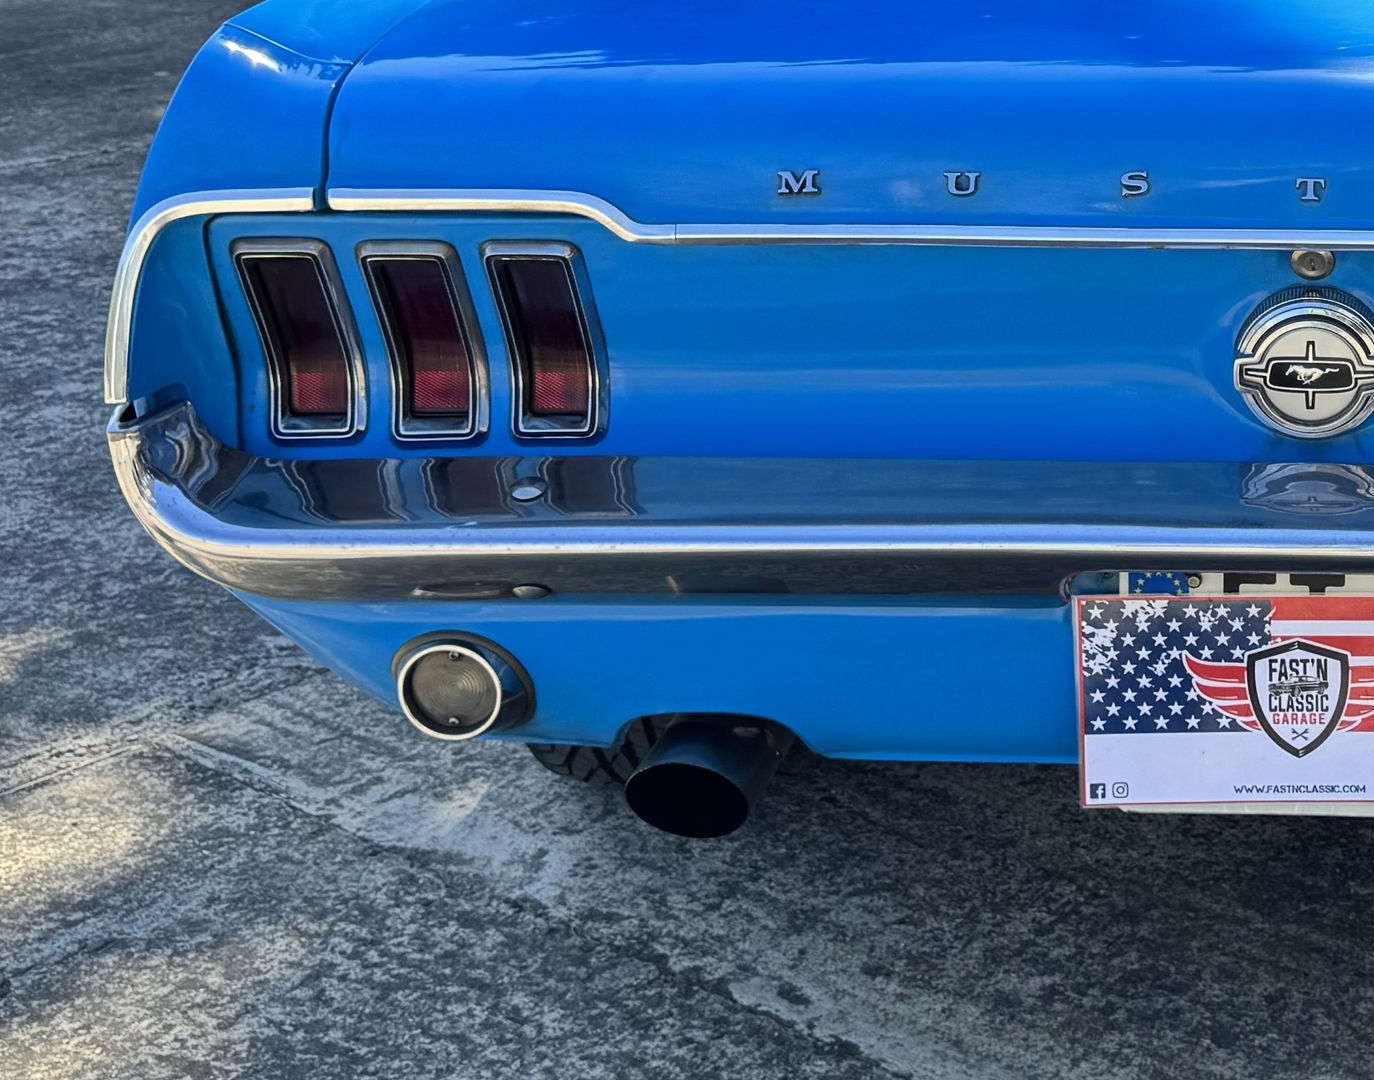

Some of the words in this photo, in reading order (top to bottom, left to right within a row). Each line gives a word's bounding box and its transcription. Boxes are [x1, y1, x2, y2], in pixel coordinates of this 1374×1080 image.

[1268, 658, 1329, 682] FAST'N
[1268, 693, 1329, 713] CLASSIC
[1272, 712, 1326, 725] GARAGE
[1233, 784, 1367, 794] WWW.FASTNCLASSIC.COM
